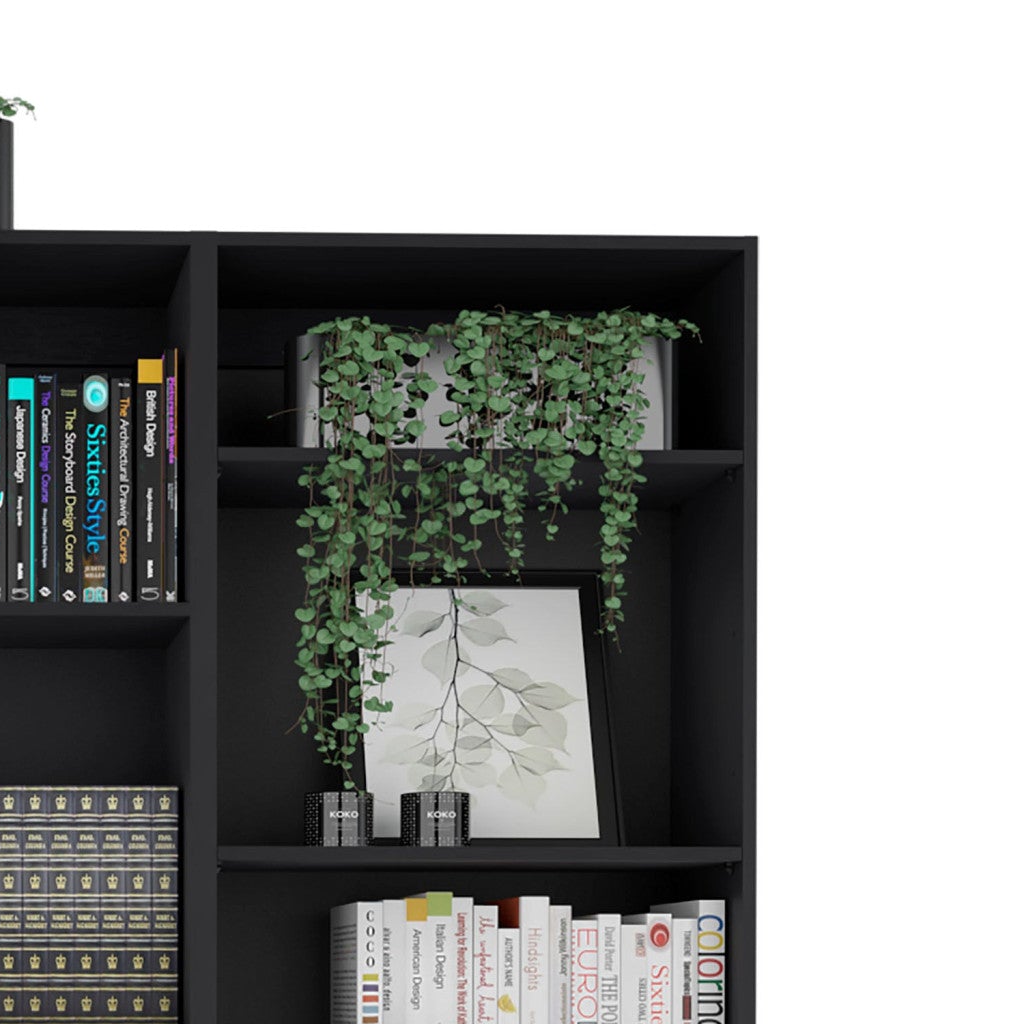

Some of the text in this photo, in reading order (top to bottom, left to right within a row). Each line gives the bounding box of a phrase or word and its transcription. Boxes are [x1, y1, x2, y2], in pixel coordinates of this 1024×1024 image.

[42, 392, 50, 406] The
[14, 405, 26, 483] Japanese Design
[42, 408, 51, 443] Ceramics
[143, 390, 156, 456] British Design
[39, 445, 50, 472] Design
[118, 397, 130, 564] The Architectural Drawing Course
[42, 474, 50, 503] Course
[63, 409, 76, 573] The Storyboard Design Course
[83, 424, 107, 553] Sixties Style
[330, 811, 359, 819] KOKO
[427, 811, 456, 819] KOKO
[409, 929, 421, 1010] American Design
[433, 924, 445, 989] Italian Design
[524, 928, 542, 991] Hindsights
[558, 954, 567, 976] Jonny
[605, 927, 615, 971] David Porter
[602, 975, 617, 1001] THE
